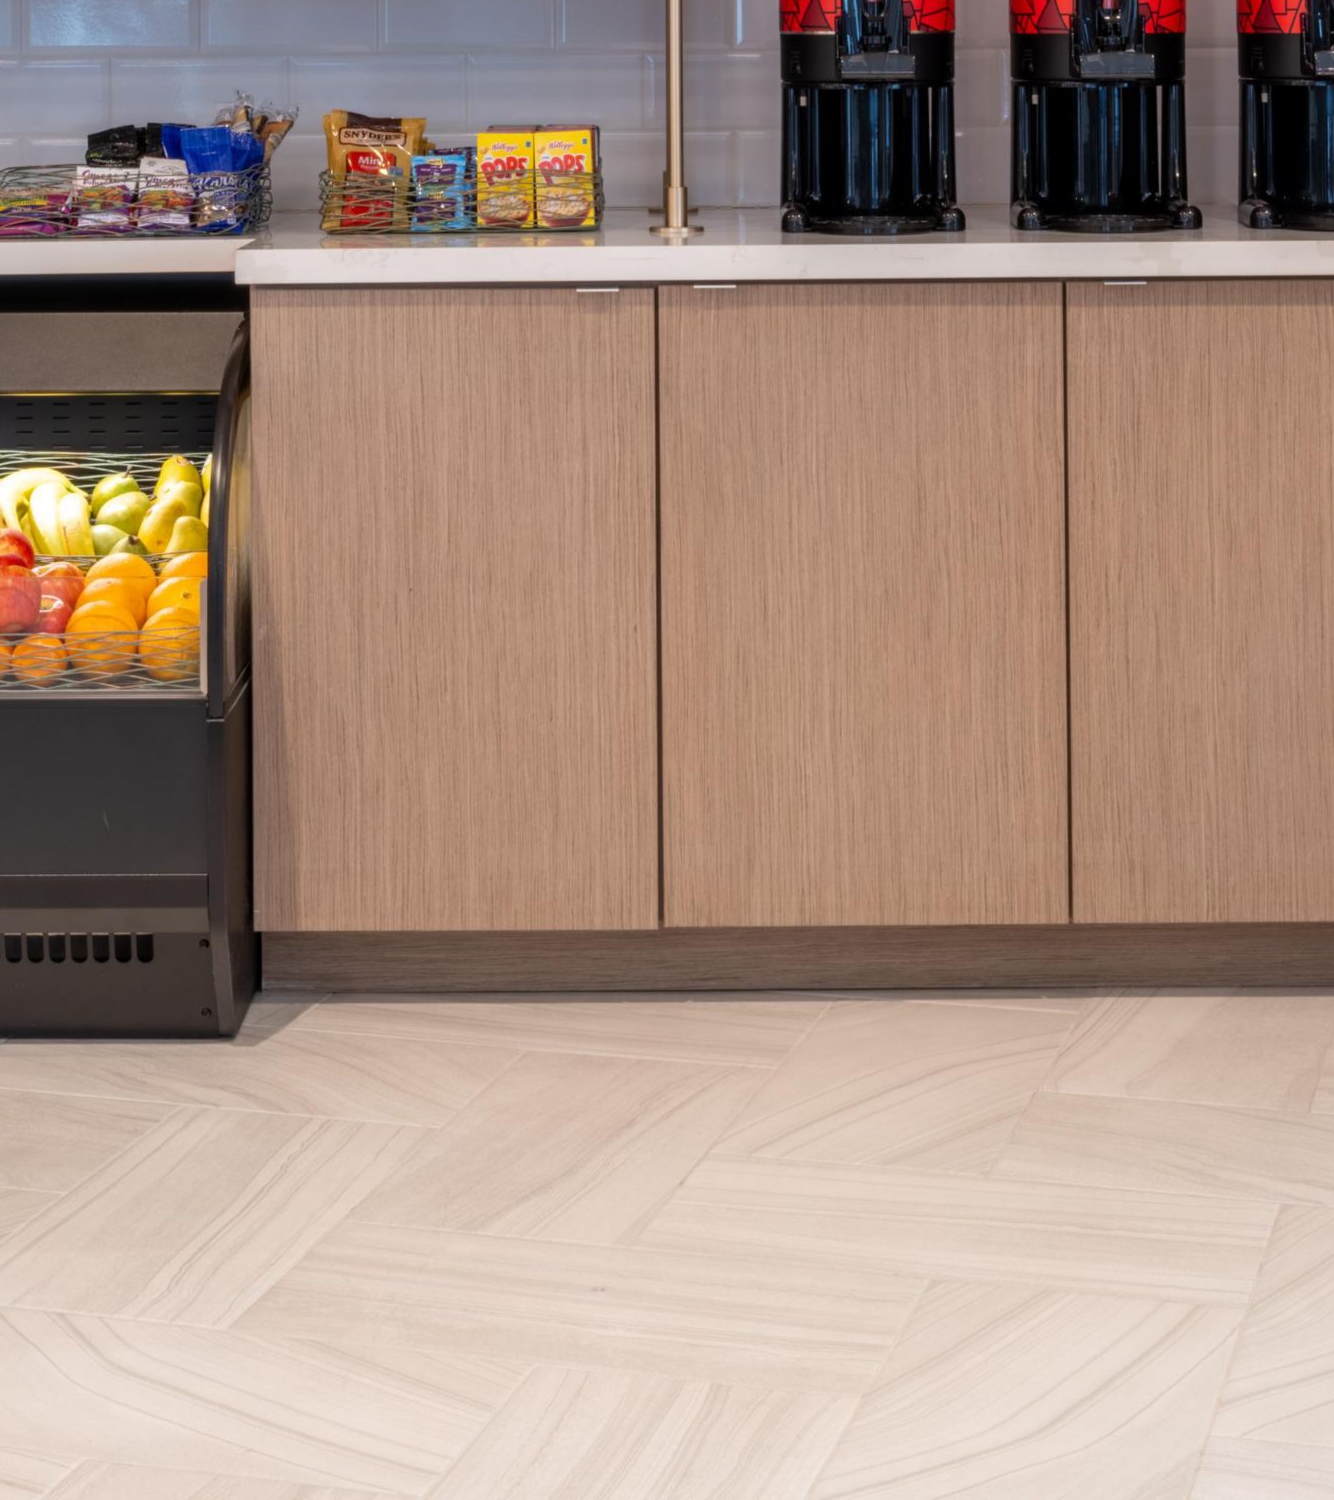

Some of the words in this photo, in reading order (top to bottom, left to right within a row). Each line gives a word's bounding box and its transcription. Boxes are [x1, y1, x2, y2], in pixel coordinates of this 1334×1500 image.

[343, 129, 402, 141] SNYDER'S
[358, 155, 385, 167] Min
[481, 156, 528, 186] POPS
[538, 154, 584, 185] POPS
